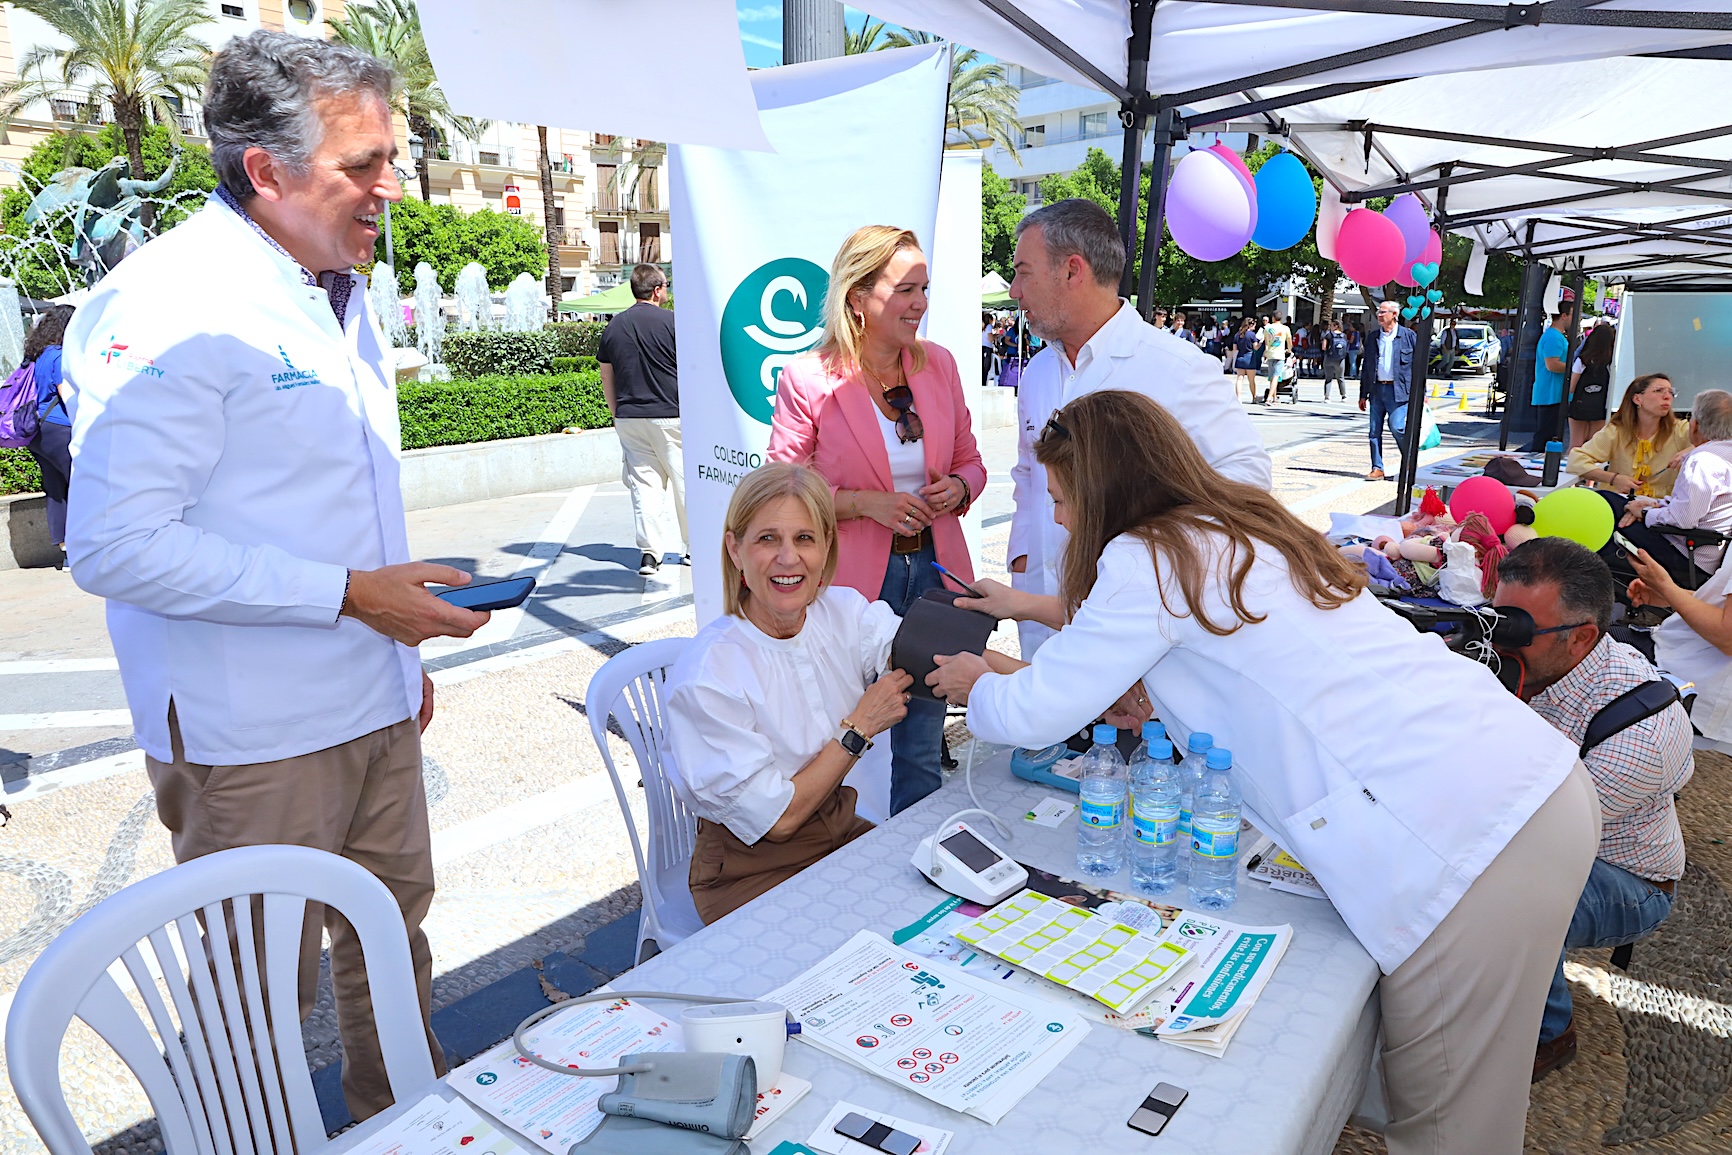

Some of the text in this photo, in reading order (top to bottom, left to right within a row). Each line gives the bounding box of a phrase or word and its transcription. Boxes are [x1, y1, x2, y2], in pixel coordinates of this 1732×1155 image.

[271, 368, 319, 384] FARMACIA
[713, 444, 761, 469] COLEGIO
[1202, 936, 1251, 998] evite las confusiones
[1209, 937, 1268, 1011] Con sus medicamentos,
[755, 1104, 770, 1116] TU
